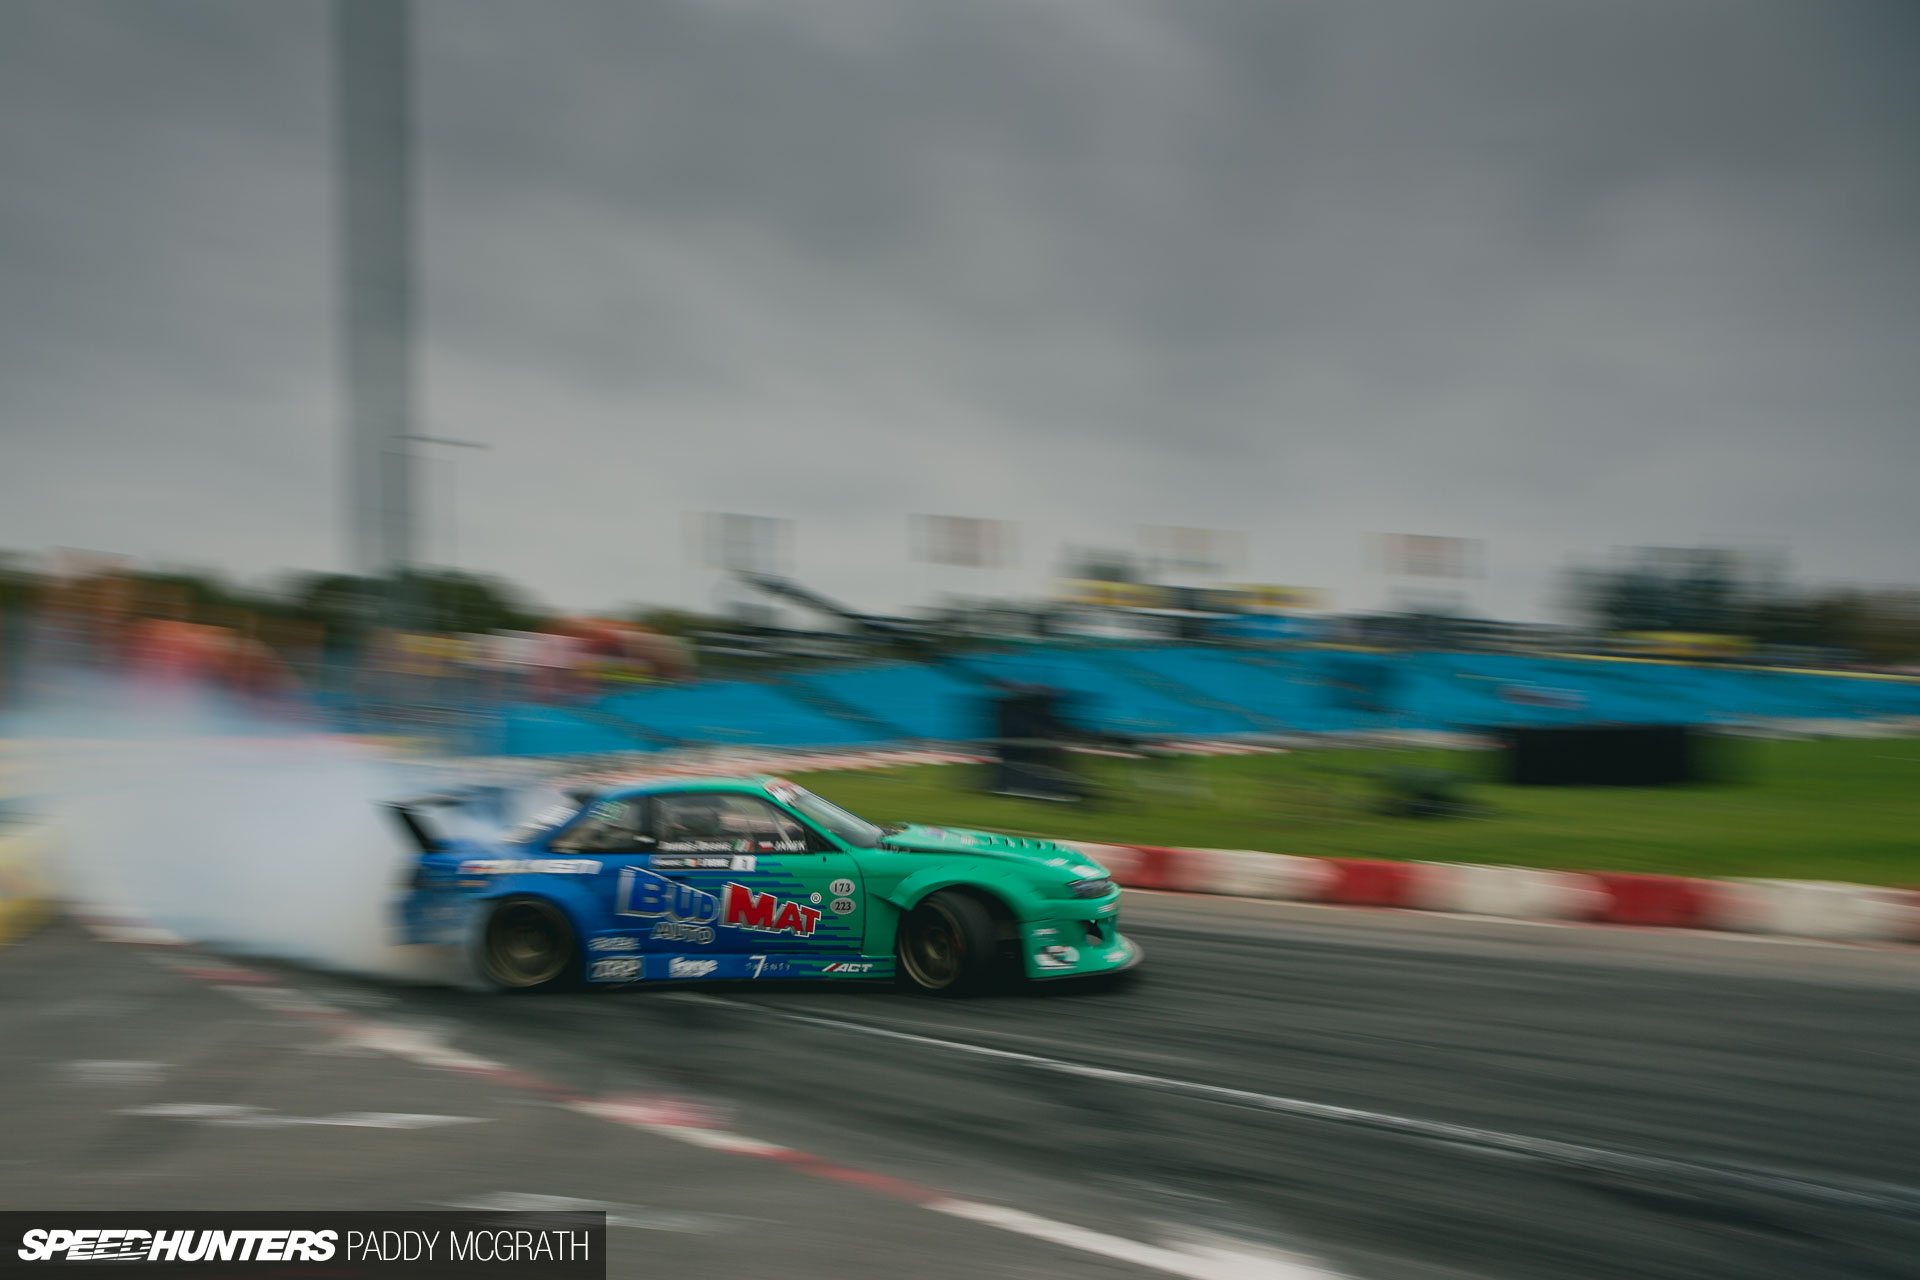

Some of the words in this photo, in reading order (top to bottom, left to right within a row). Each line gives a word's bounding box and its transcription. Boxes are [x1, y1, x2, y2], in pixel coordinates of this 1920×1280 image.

[834, 882, 851, 893] 173
[835, 901, 852, 911] 223
[650, 921, 716, 945] AUTO
